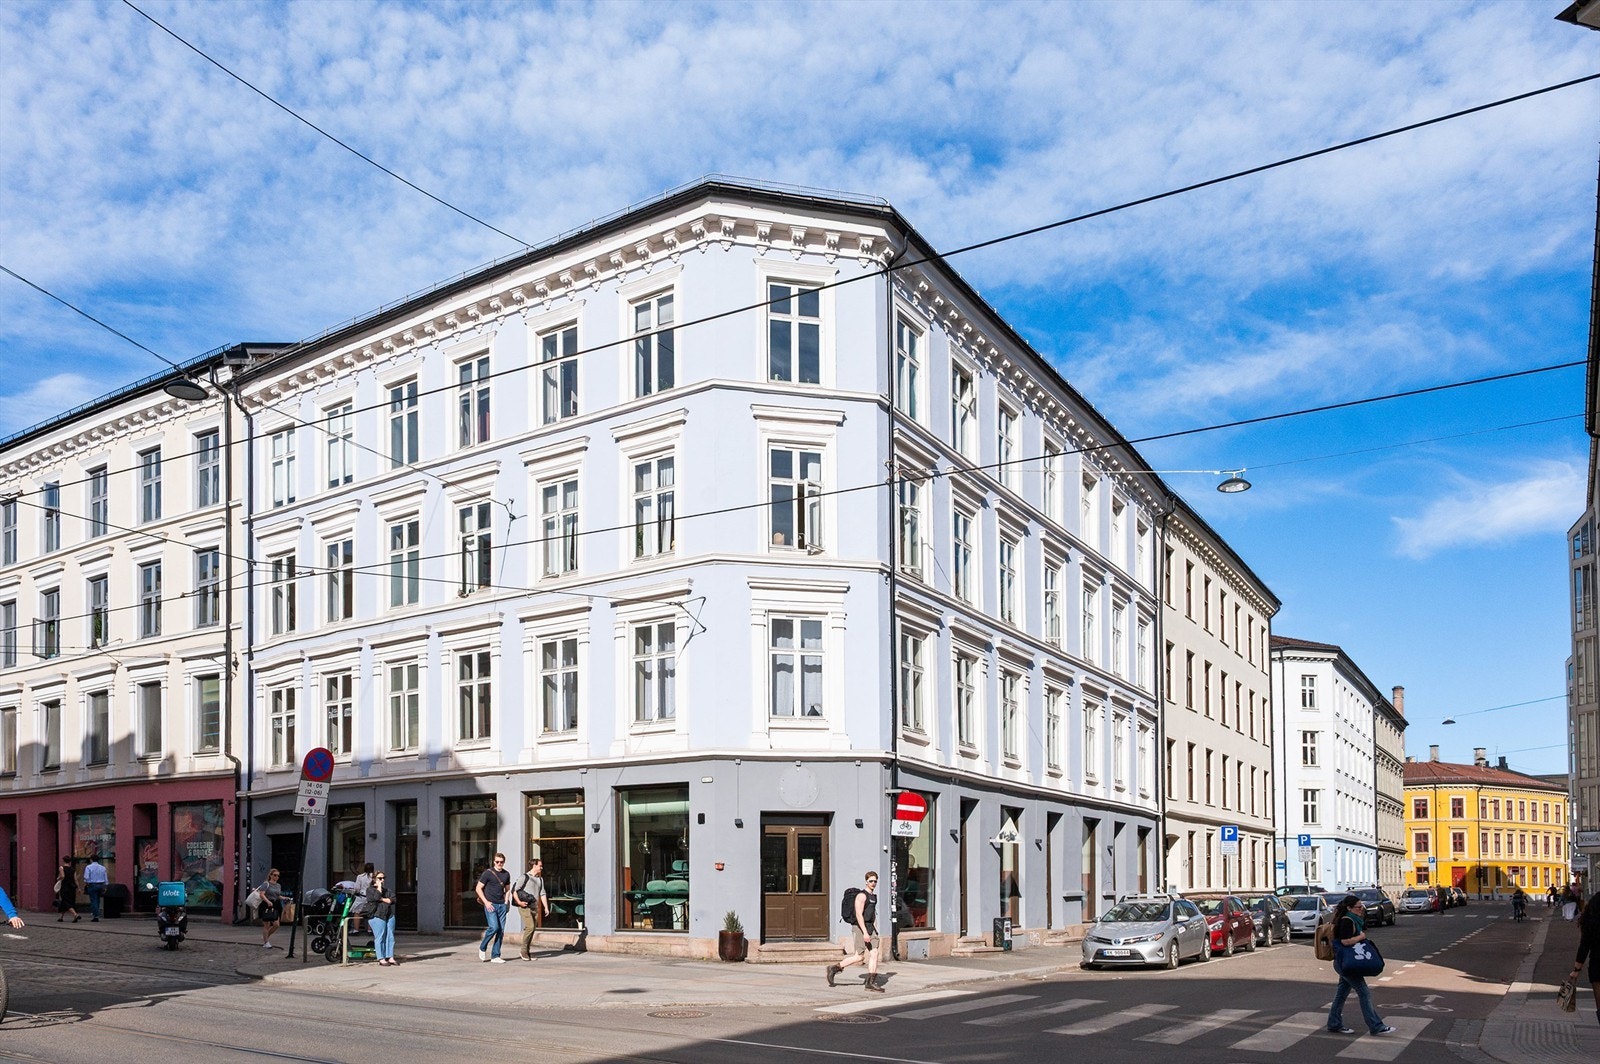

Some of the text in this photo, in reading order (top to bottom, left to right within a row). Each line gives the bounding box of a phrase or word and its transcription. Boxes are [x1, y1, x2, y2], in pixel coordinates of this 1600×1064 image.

[1225, 828, 1234, 840] P
[1300, 835, 1308, 845] P
[162, 889, 180, 897] Wolt
